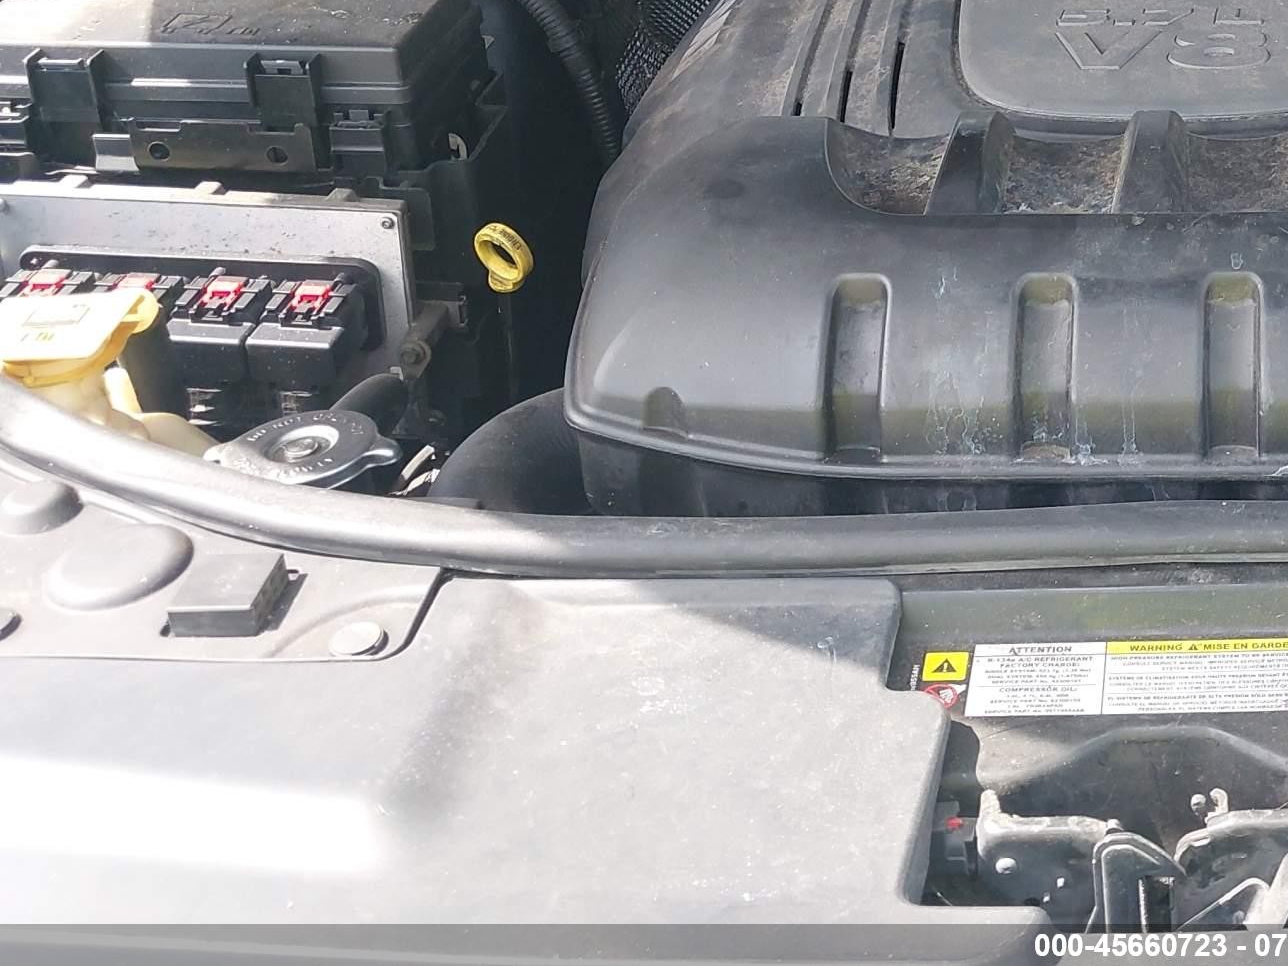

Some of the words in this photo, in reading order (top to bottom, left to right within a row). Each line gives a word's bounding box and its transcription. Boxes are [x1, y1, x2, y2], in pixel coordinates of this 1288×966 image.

[1055, 30, 1272, 70] V8
[1008, 645, 1073, 654] ATTENTION
[1129, 643, 1183, 652] WARNING
[1203, 642, 1230, 651] MISE
[1233, 642, 1248, 650] EN
[1251, 641, 1288, 649] GARDE
